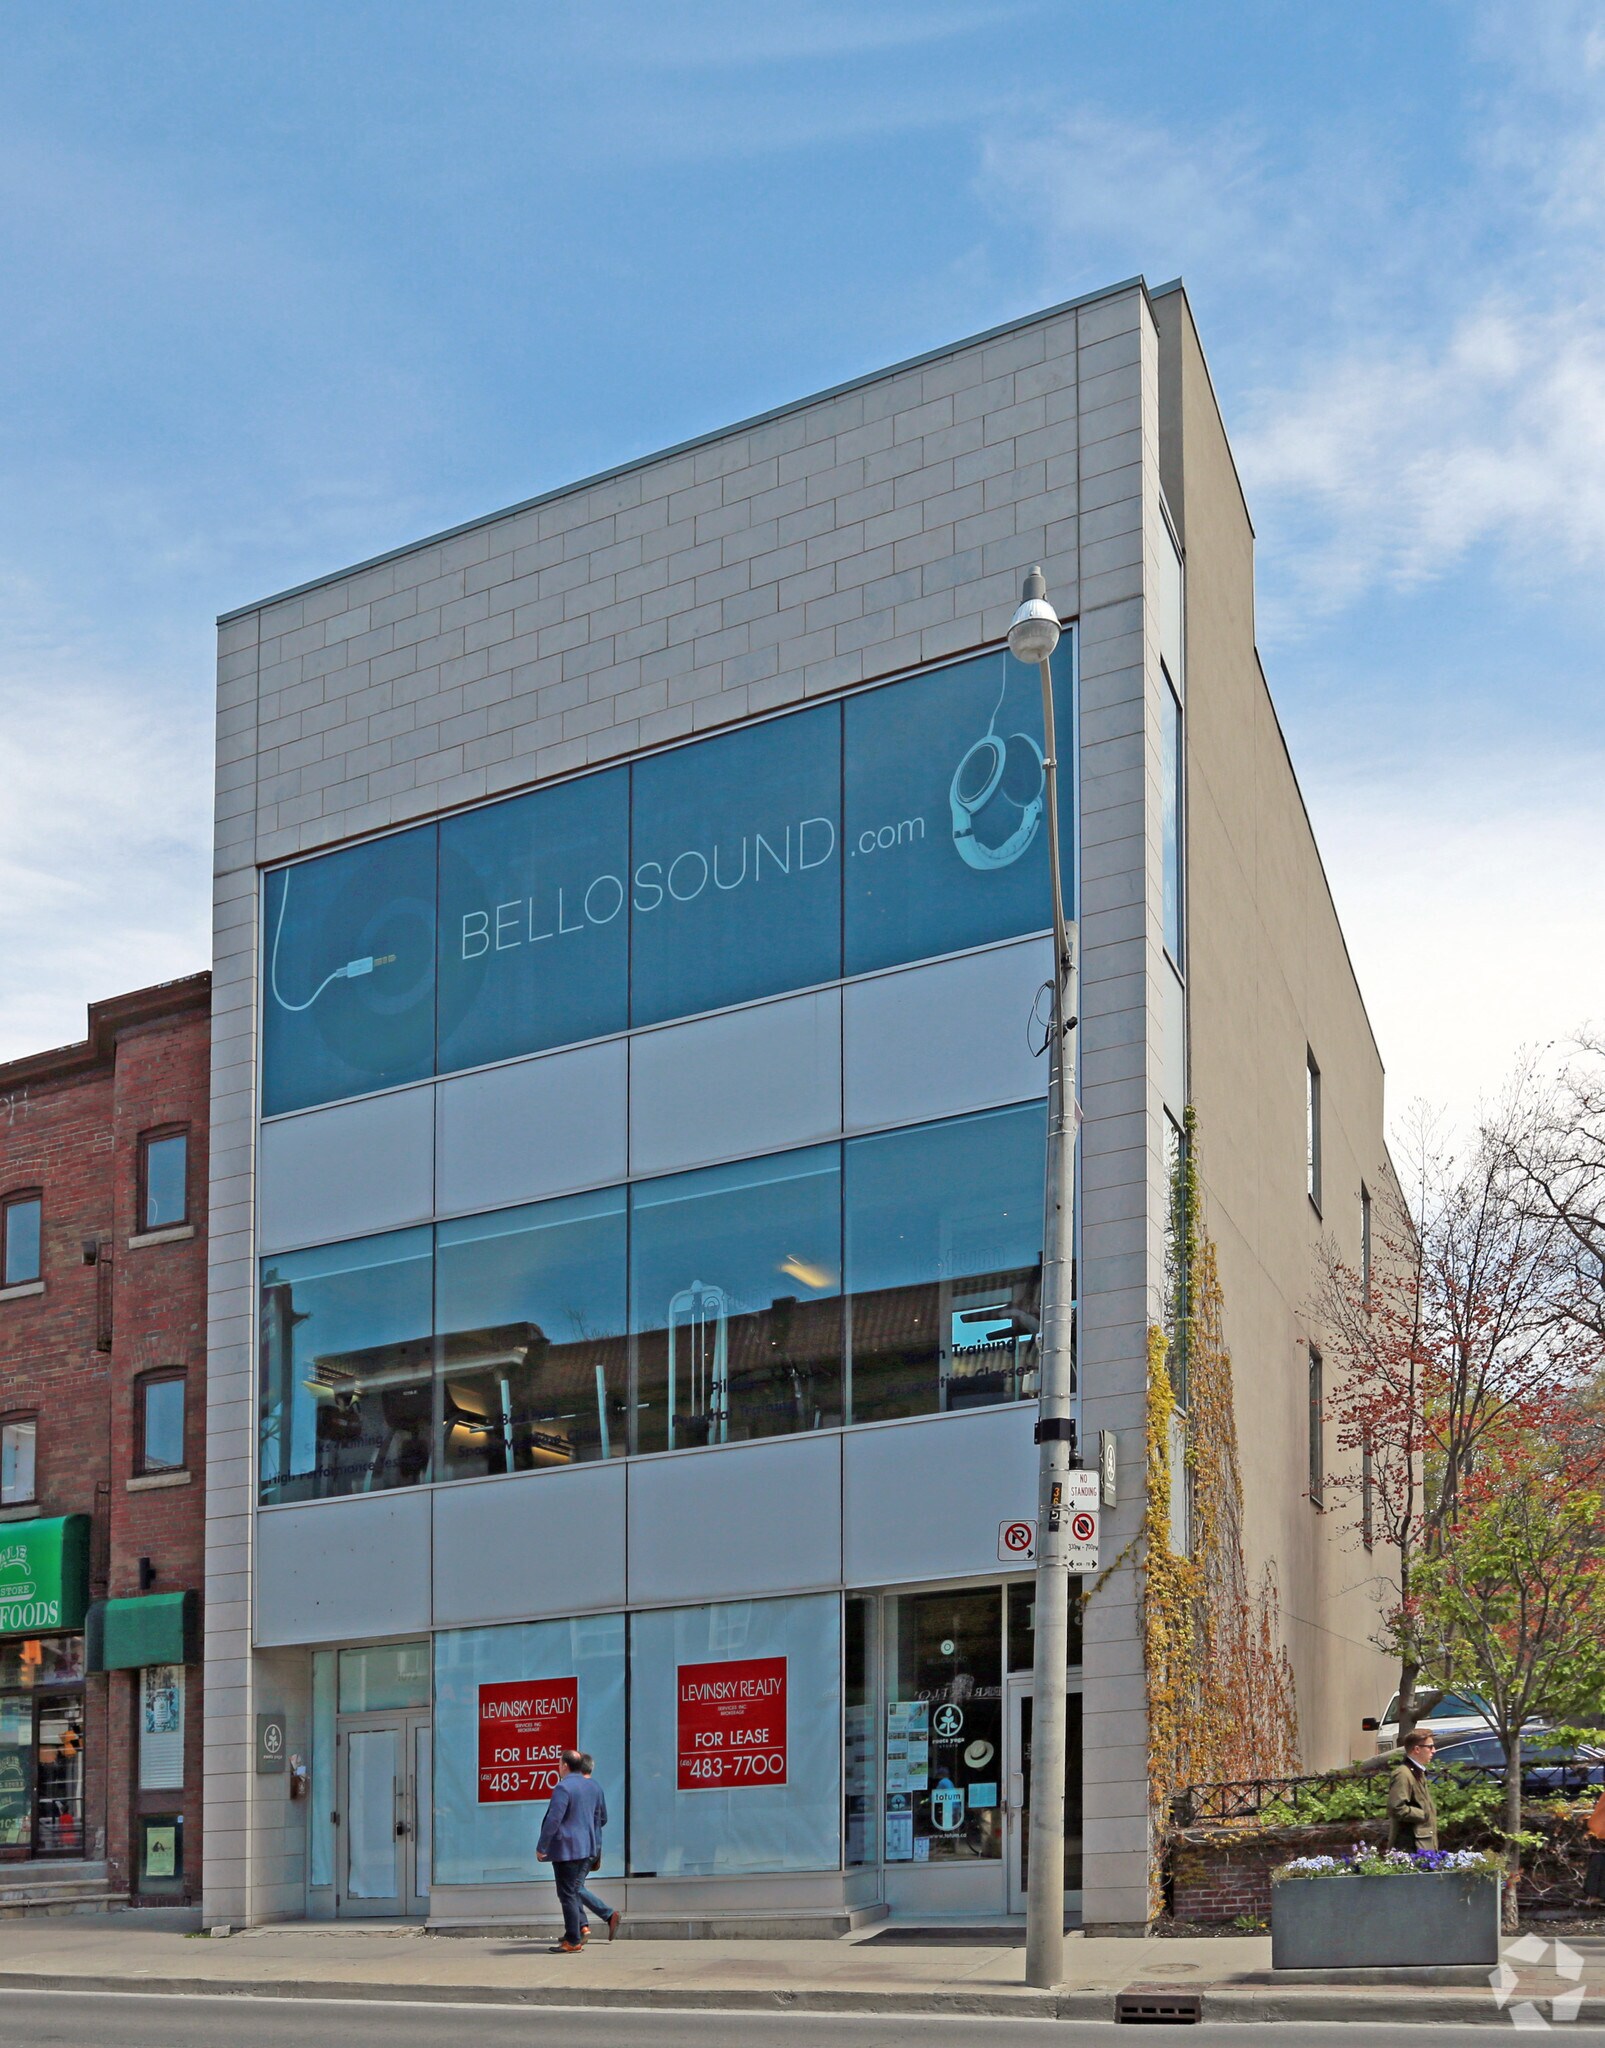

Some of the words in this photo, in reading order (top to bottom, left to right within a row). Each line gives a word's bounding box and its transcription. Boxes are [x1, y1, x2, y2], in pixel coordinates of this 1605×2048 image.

[951, 1338, 1017, 1358] Training
[1079, 1473, 1088, 1484] NO
[1070, 1486, 1098, 1497] STANDING
[0, 1585, 30, 1597] STORE
[0, 1600, 59, 1630] FOODS
[682, 1680, 739, 1702] LEVINSKY
[739, 1677, 783, 1698] REALTY
[482, 1699, 534, 1719] LEVINSKY
[535, 1696, 574, 1715] REALTY
[695, 1731, 723, 1748] FOR
[729, 1728, 769, 1745] LEASE
[494, 1747, 520, 1763] FOR
[526, 1745, 562, 1761] LEASE
[690, 1753, 784, 1778] 483-7700
[489, 1769, 563, 1792] 483-770
[935, 1792, 961, 1801] totum
